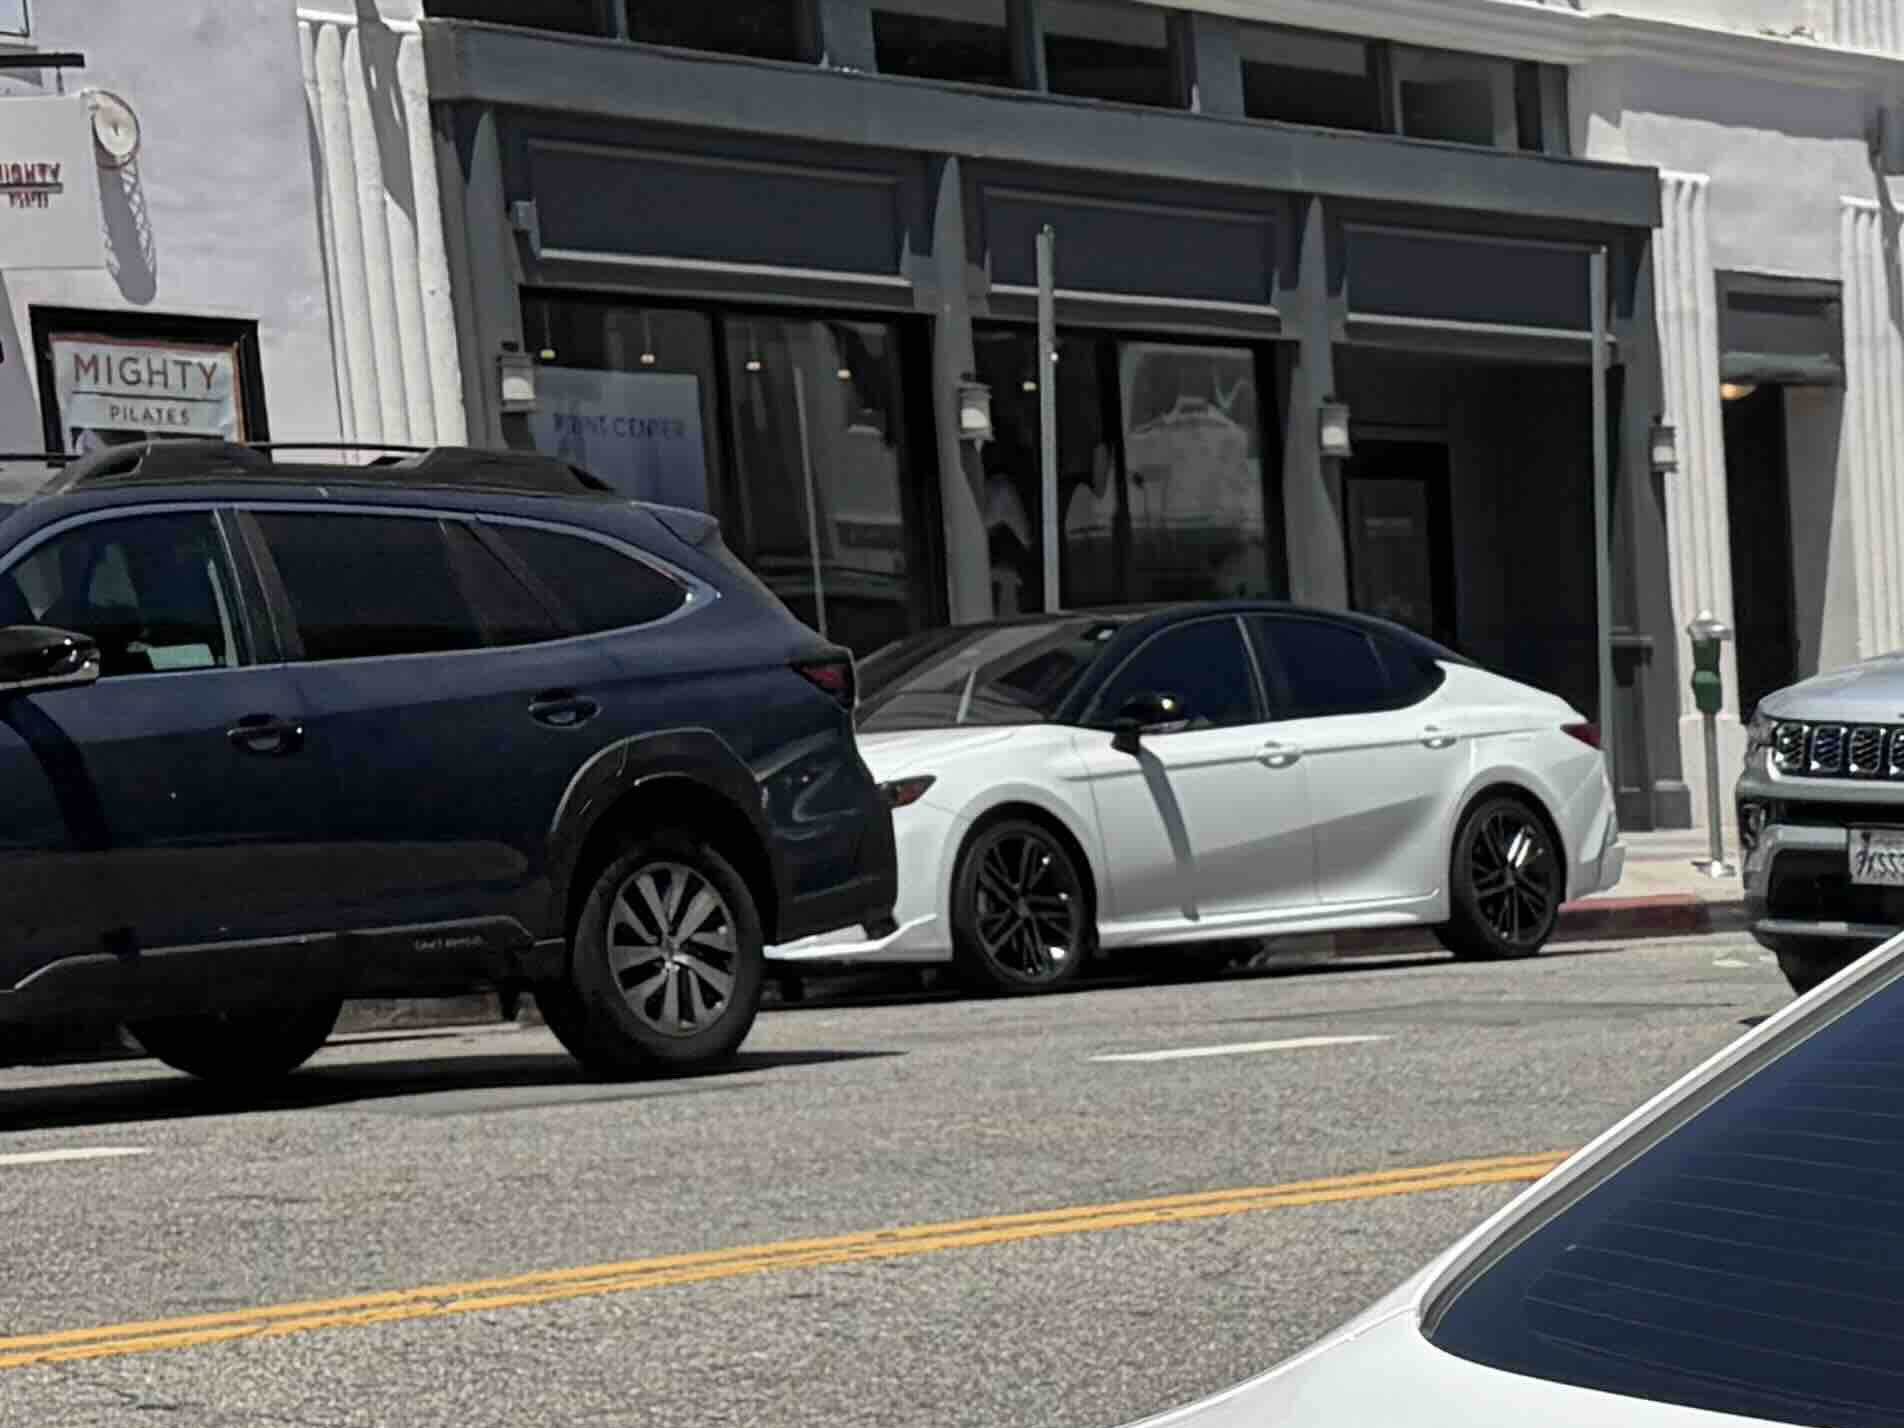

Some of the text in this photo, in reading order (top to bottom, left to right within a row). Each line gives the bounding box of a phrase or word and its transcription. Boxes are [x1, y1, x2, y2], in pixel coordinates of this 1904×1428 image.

[0, 163, 61, 182] IGHTY
[74, 353, 218, 390] MIGHTY
[108, 405, 191, 426] PILATES
